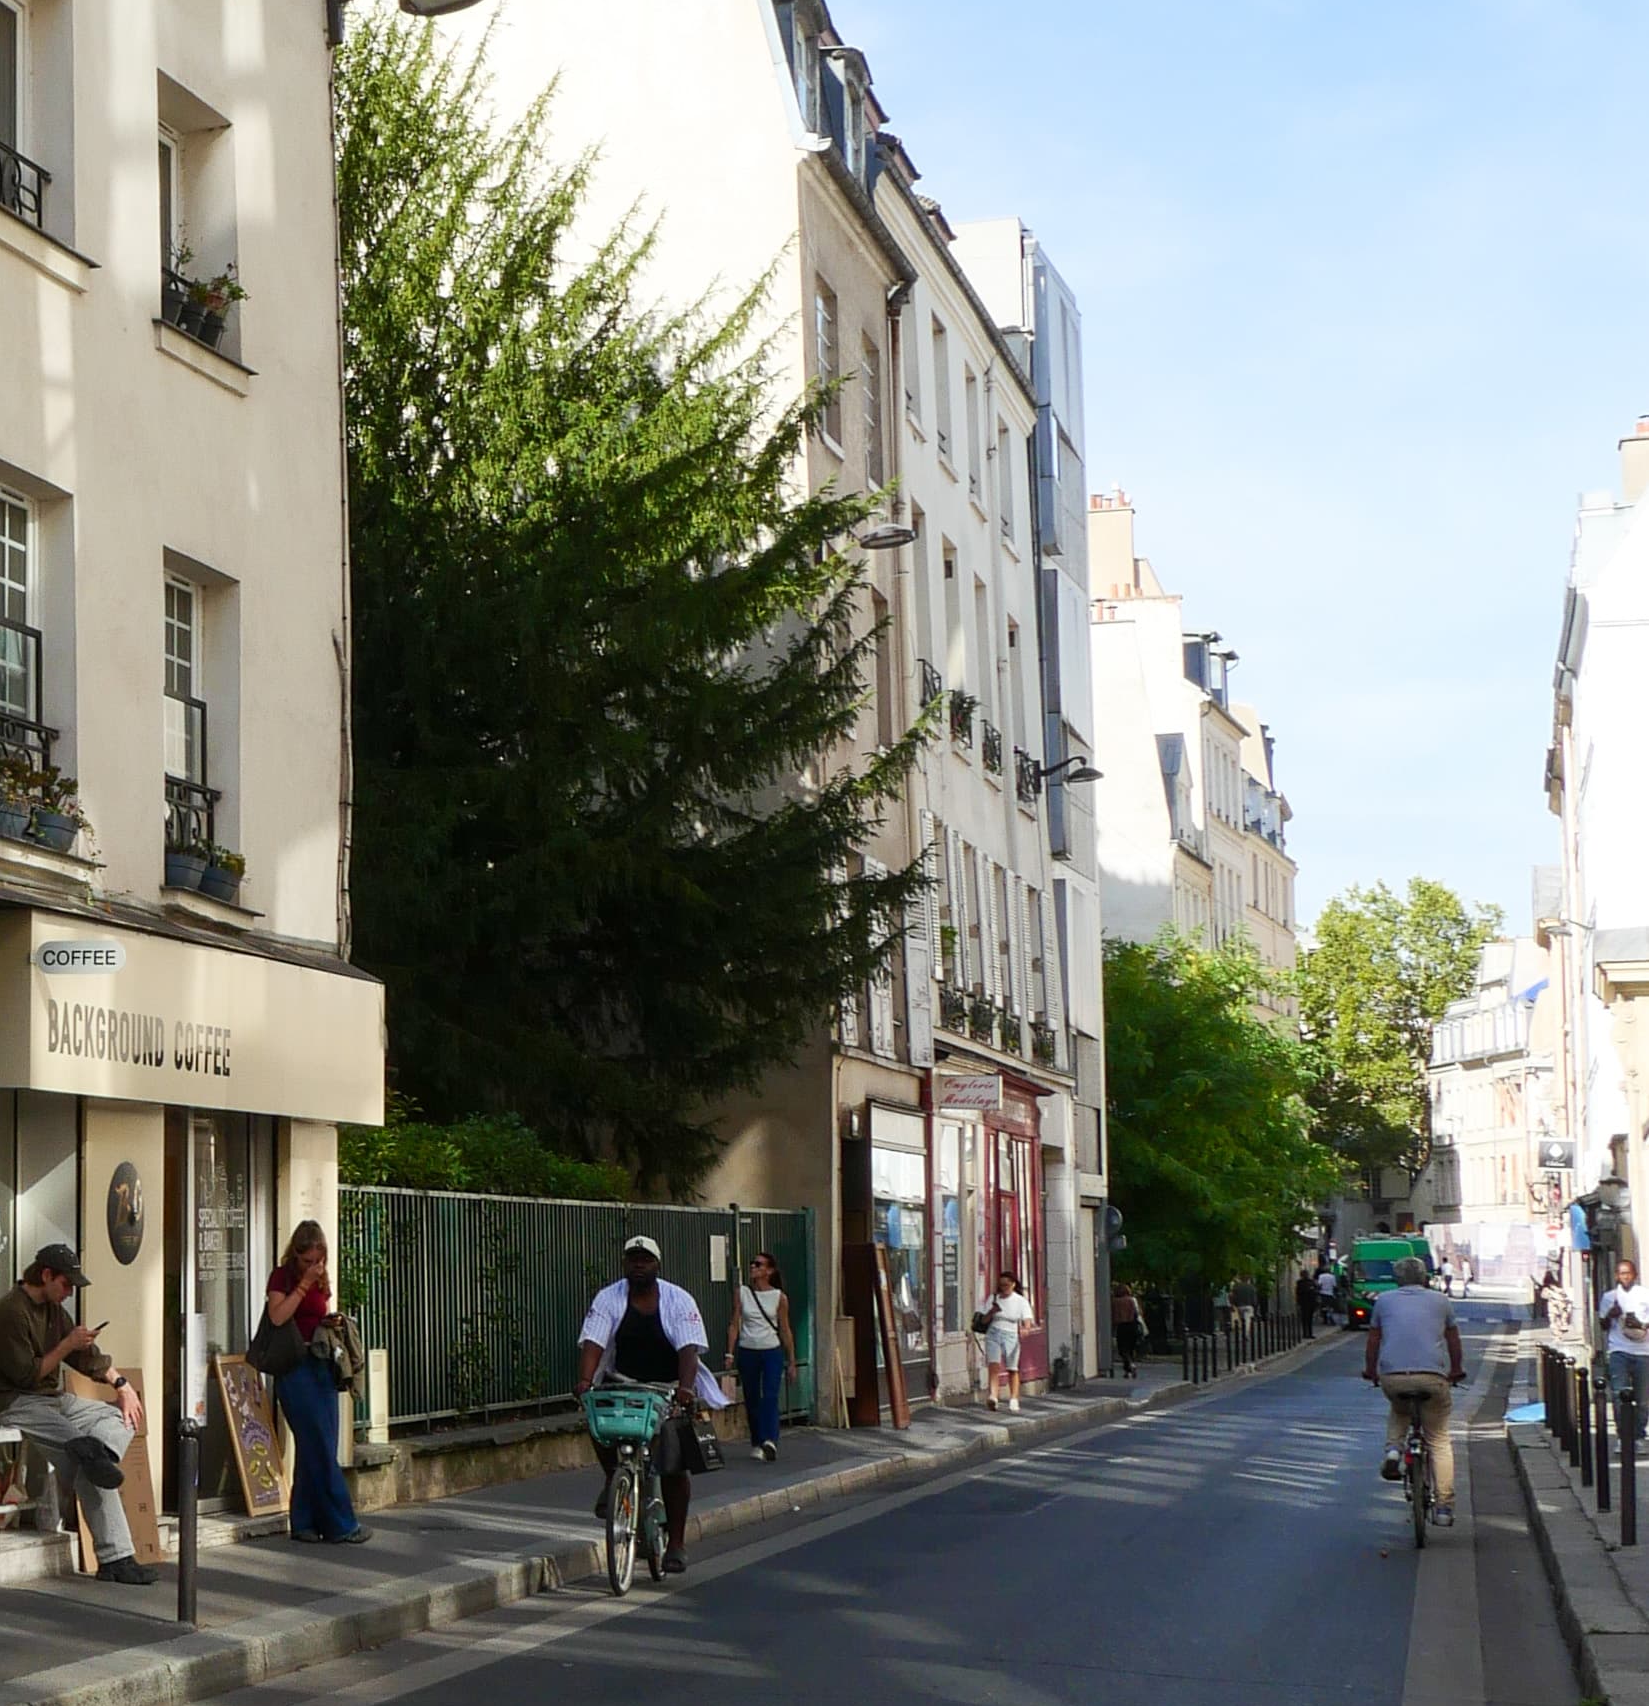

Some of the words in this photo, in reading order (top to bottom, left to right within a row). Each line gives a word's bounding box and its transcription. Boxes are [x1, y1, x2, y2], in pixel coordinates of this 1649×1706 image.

[43, 950, 116, 966] COFFEE
[48, 998, 165, 1068] BACKGROUND
[174, 1021, 231, 1077] COFFEE
